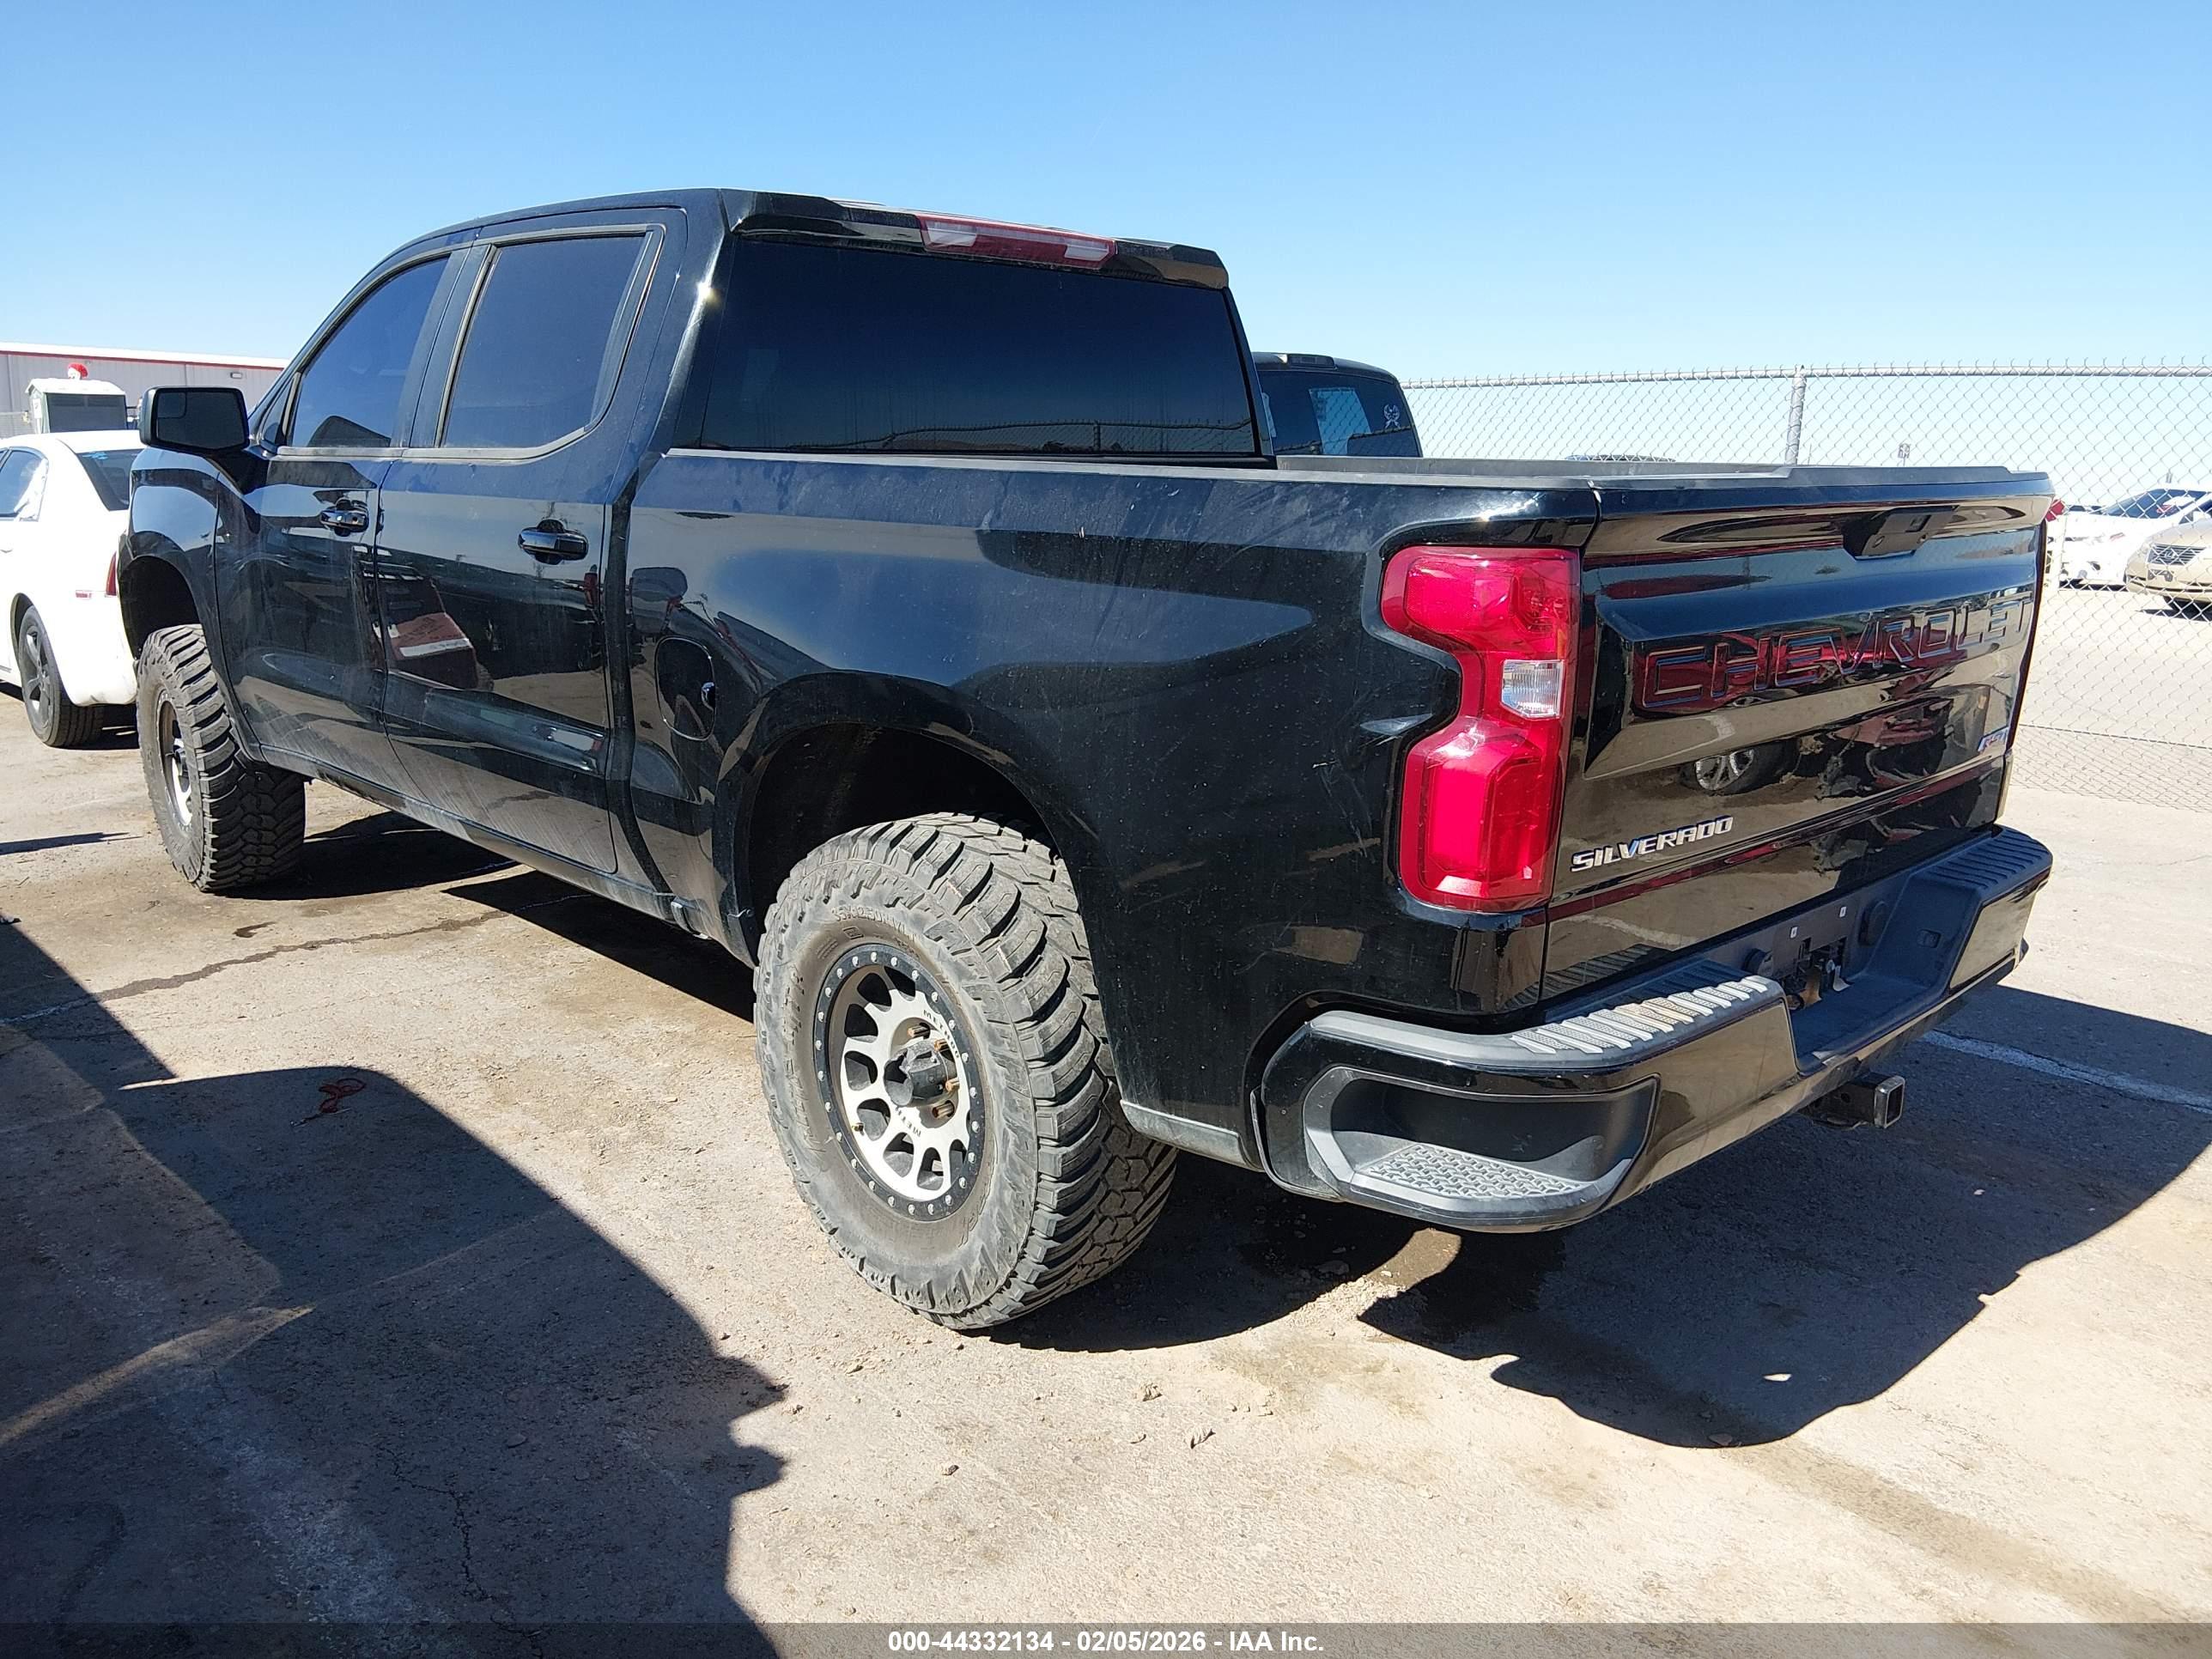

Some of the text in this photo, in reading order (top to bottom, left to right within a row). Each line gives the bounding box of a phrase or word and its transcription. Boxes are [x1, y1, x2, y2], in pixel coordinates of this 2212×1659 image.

[1643, 591, 2033, 708] CHEVROLET
[1570, 815, 1734, 872] SILVERADO
[923, 1009, 960, 1059] METHOD
